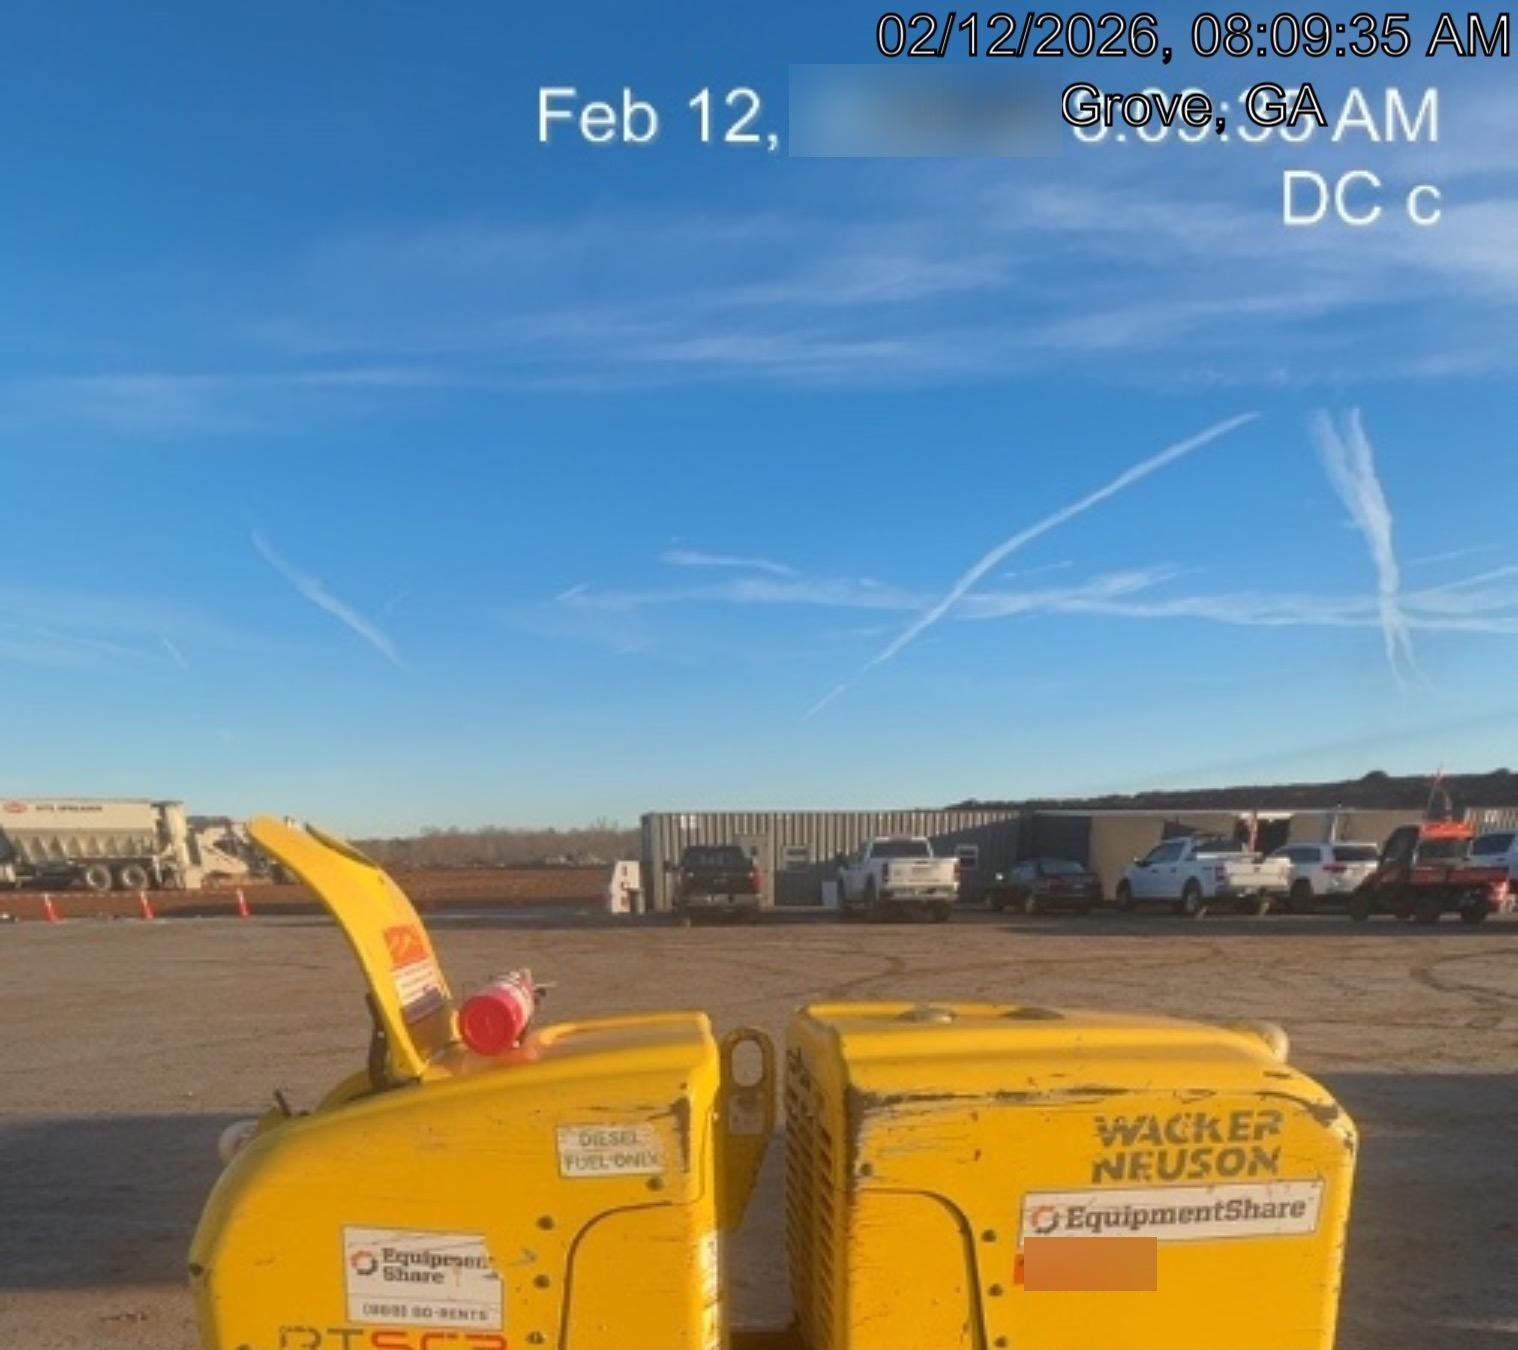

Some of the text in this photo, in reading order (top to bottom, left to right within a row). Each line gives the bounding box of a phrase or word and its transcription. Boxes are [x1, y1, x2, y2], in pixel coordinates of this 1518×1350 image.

[578, 1130, 638, 1147] DIESEL
[1094, 1109, 1284, 1147] WACKER
[566, 1150, 659, 1171] FUEL ONLY
[1091, 1146, 1281, 1184] NEUSON
[1064, 1199, 1306, 1231] EquipmentShare
[383, 1265, 445, 1285] Share
